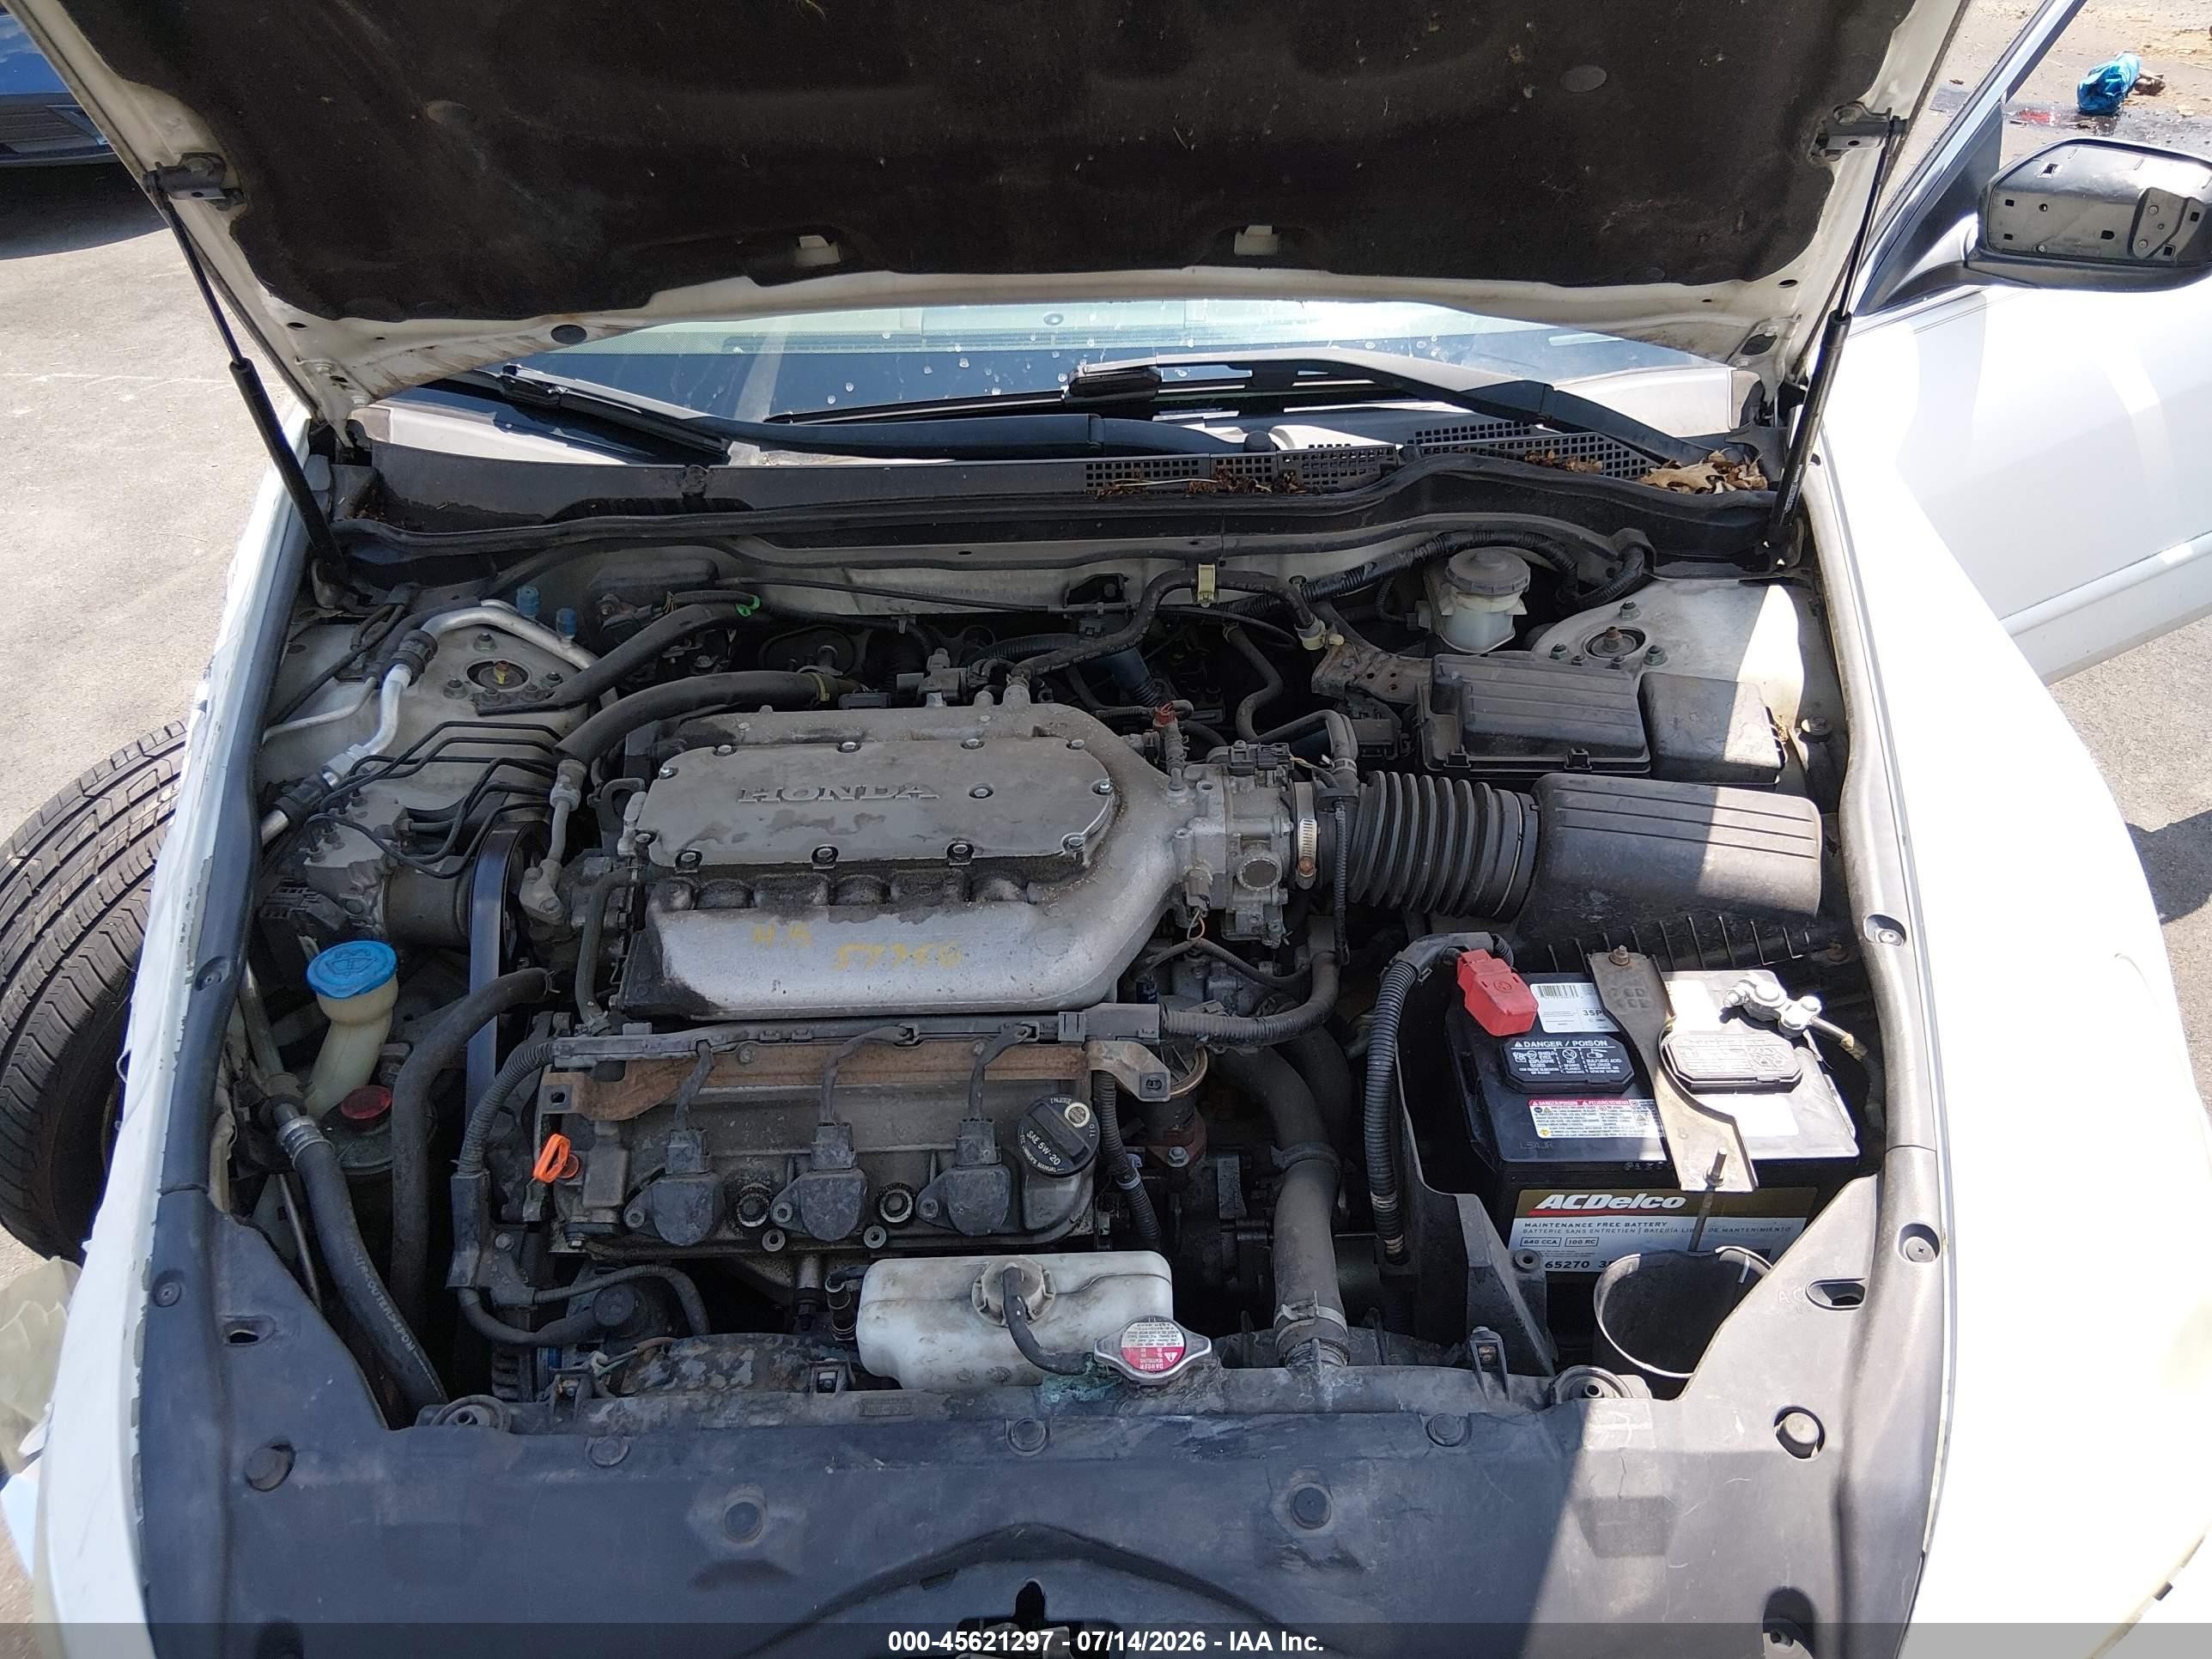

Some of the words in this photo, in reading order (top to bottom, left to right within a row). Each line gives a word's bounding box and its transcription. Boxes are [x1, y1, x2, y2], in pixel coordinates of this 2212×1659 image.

[737, 784, 939, 804] HONDA
[1026, 1129, 1041, 1145] SAE
[1037, 1142, 1061, 1165] 5W-20
[1534, 1193, 1686, 1210] ACDelco
